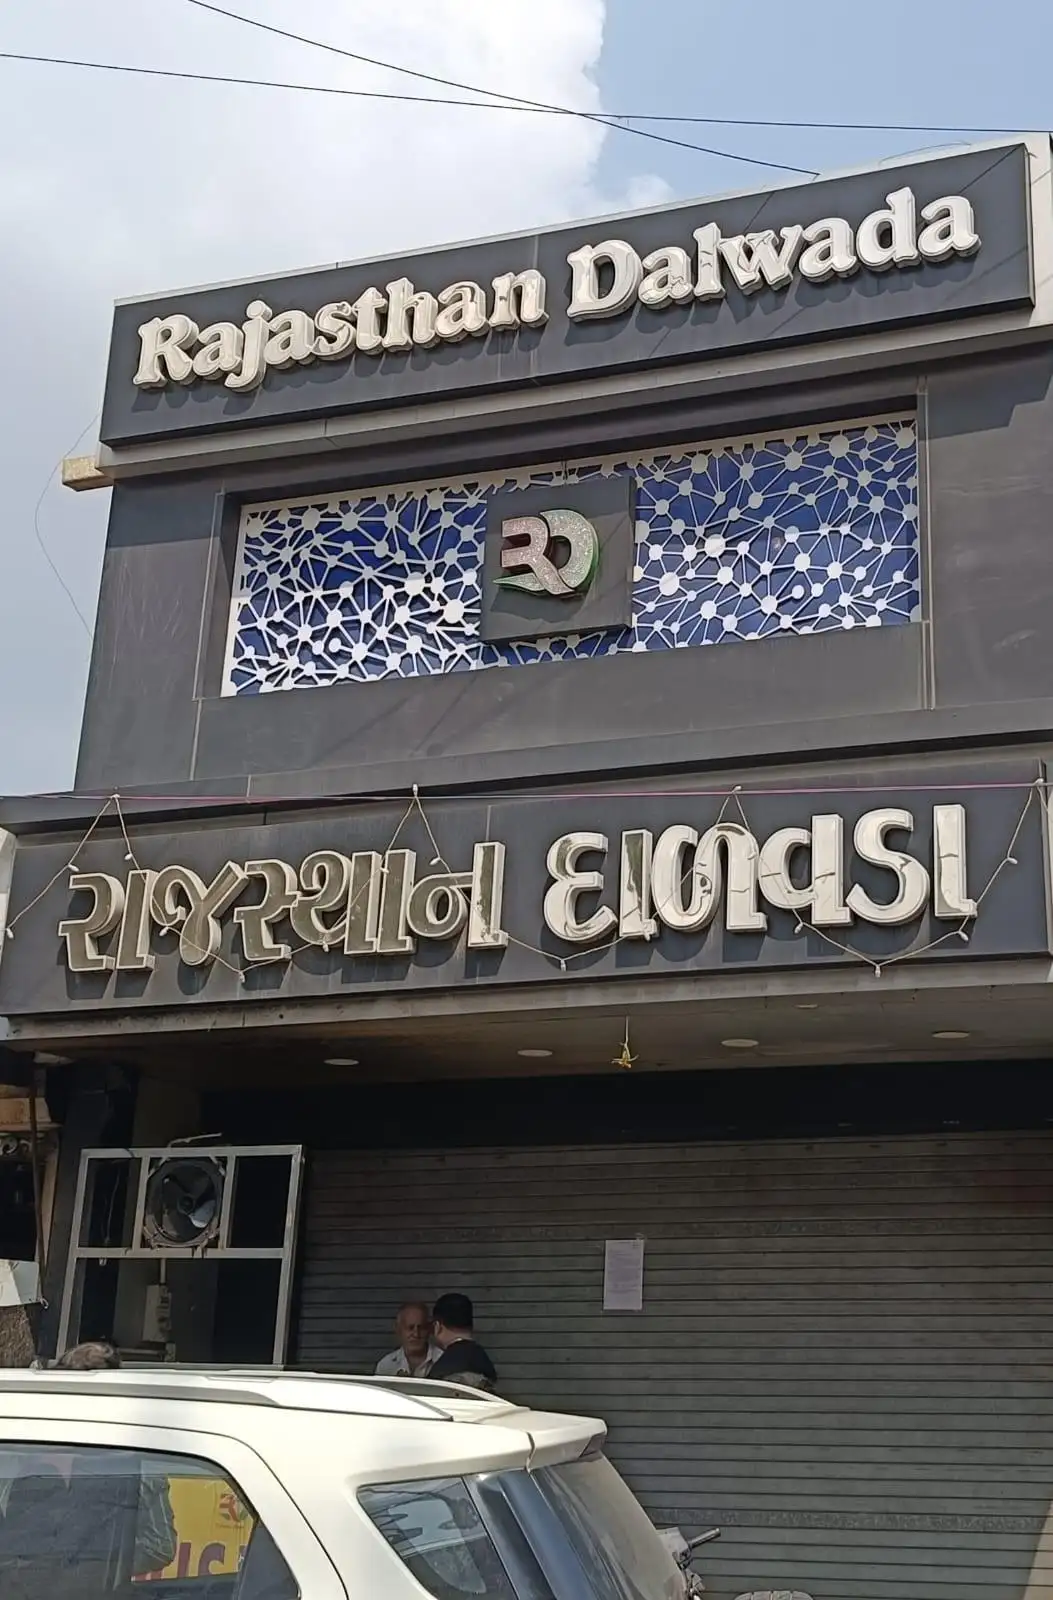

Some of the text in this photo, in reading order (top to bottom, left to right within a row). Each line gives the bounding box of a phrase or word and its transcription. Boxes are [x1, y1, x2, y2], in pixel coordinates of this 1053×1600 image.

[133, 186, 981, 392] Rajasthan Dalwada
[58, 803, 978, 972] રાજસ્થાન દાળવડા
